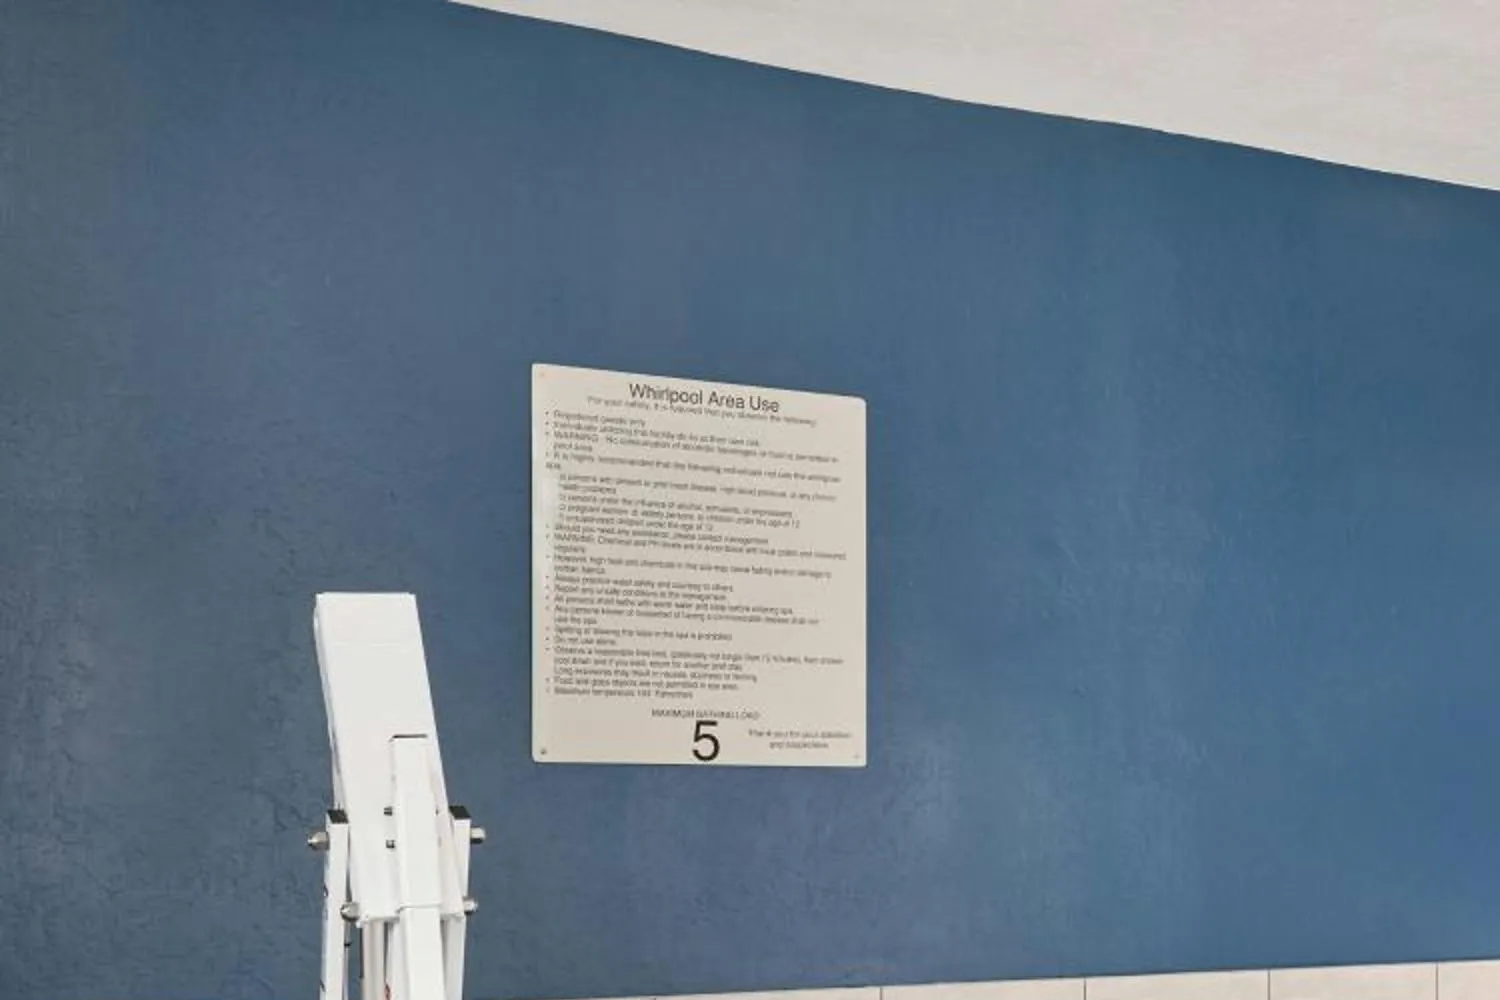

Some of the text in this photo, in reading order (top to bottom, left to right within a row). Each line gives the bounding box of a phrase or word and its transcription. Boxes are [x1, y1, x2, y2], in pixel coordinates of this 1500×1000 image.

[629, 383, 780, 412] Whirlpool Area Use
[692, 720, 720, 761] 5
